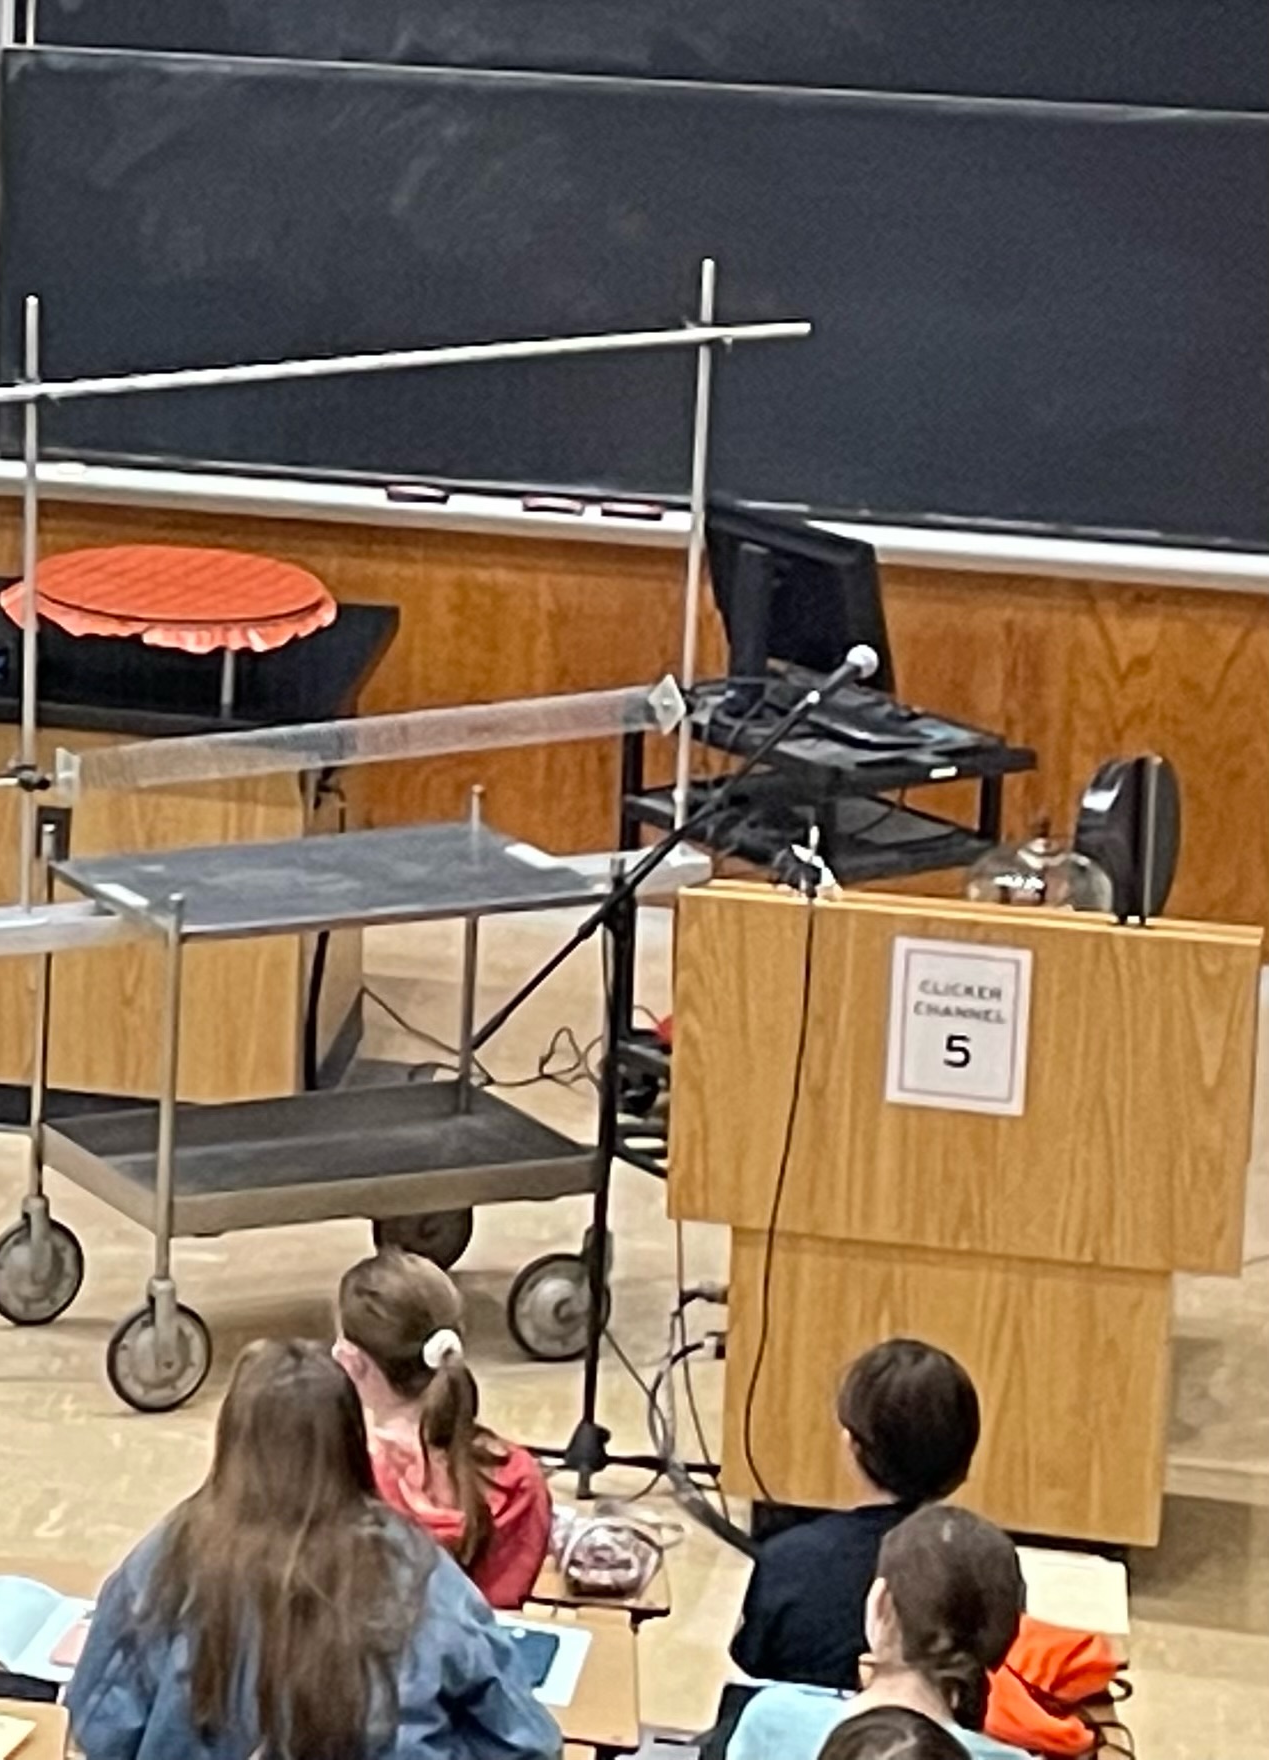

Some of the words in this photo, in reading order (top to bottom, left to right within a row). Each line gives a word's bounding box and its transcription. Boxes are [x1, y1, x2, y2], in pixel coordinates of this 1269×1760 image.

[918, 979, 1002, 999] CLICKER
[913, 1000, 1006, 1024] CHANNEL
[943, 1034, 971, 1068] 5
